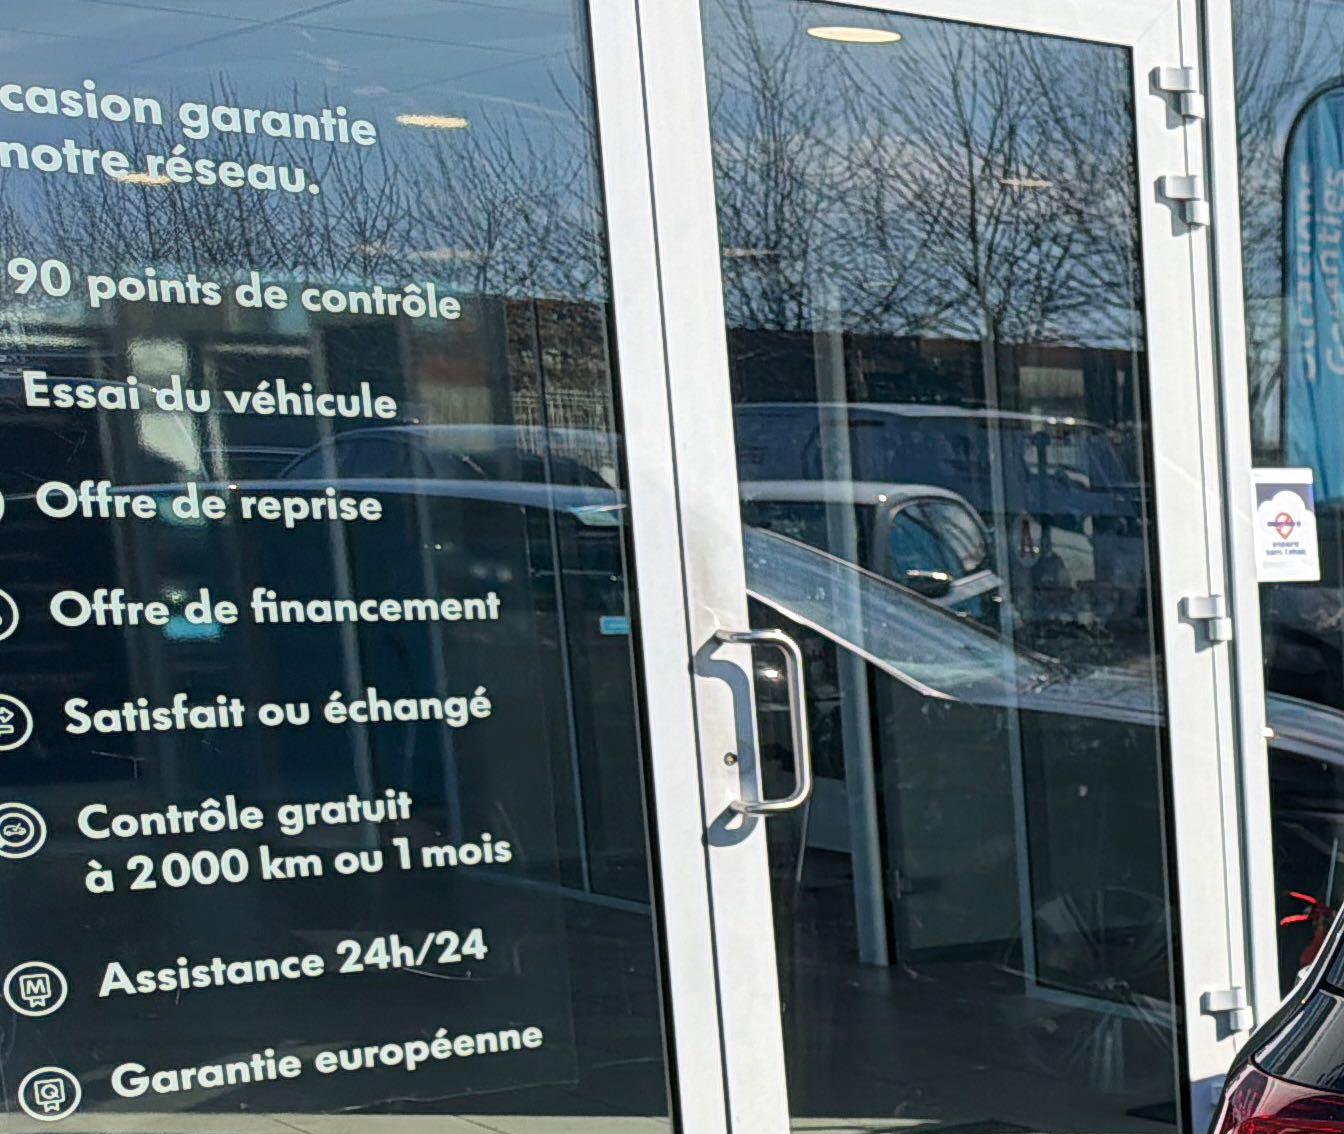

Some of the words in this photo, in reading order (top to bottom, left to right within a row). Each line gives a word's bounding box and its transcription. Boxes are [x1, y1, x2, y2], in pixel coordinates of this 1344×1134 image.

[179, 101, 378, 147] garantie
[0, 138, 130, 179] notre
[147, 144, 320, 195] réseau.
[8, 258, 71, 297] 90
[87, 265, 222, 308] points
[235, 269, 288, 310] de
[301, 281, 462, 320] contrôle
[23, 371, 140, 410] Essai
[156, 375, 211, 413] du
[225, 379, 397, 419] véhicule
[35, 480, 156, 519] Offre
[171, 483, 225, 520] de
[241, 487, 383, 529] reprise
[50, 589, 169, 627] Offre
[184, 589, 238, 625] de
[251, 588, 501, 623] financement
[64, 693, 245, 734] Satisfait
[258, 702, 309, 726] ou
[323, 686, 492, 728] échangé
[78, 795, 264, 839] Contrôle
[278, 789, 412, 836] gratuit
[86, 860, 114, 894] à
[261, 846, 322, 880] km
[334, 850, 384, 875] ou
[393, 837, 410, 870] 1
[422, 833, 512, 868] mois
[99, 958, 325, 998] Assistance
[336, 928, 488, 974] 24h/24
[111, 1049, 301, 1098] Garantie
[314, 1026, 543, 1074] européenne
